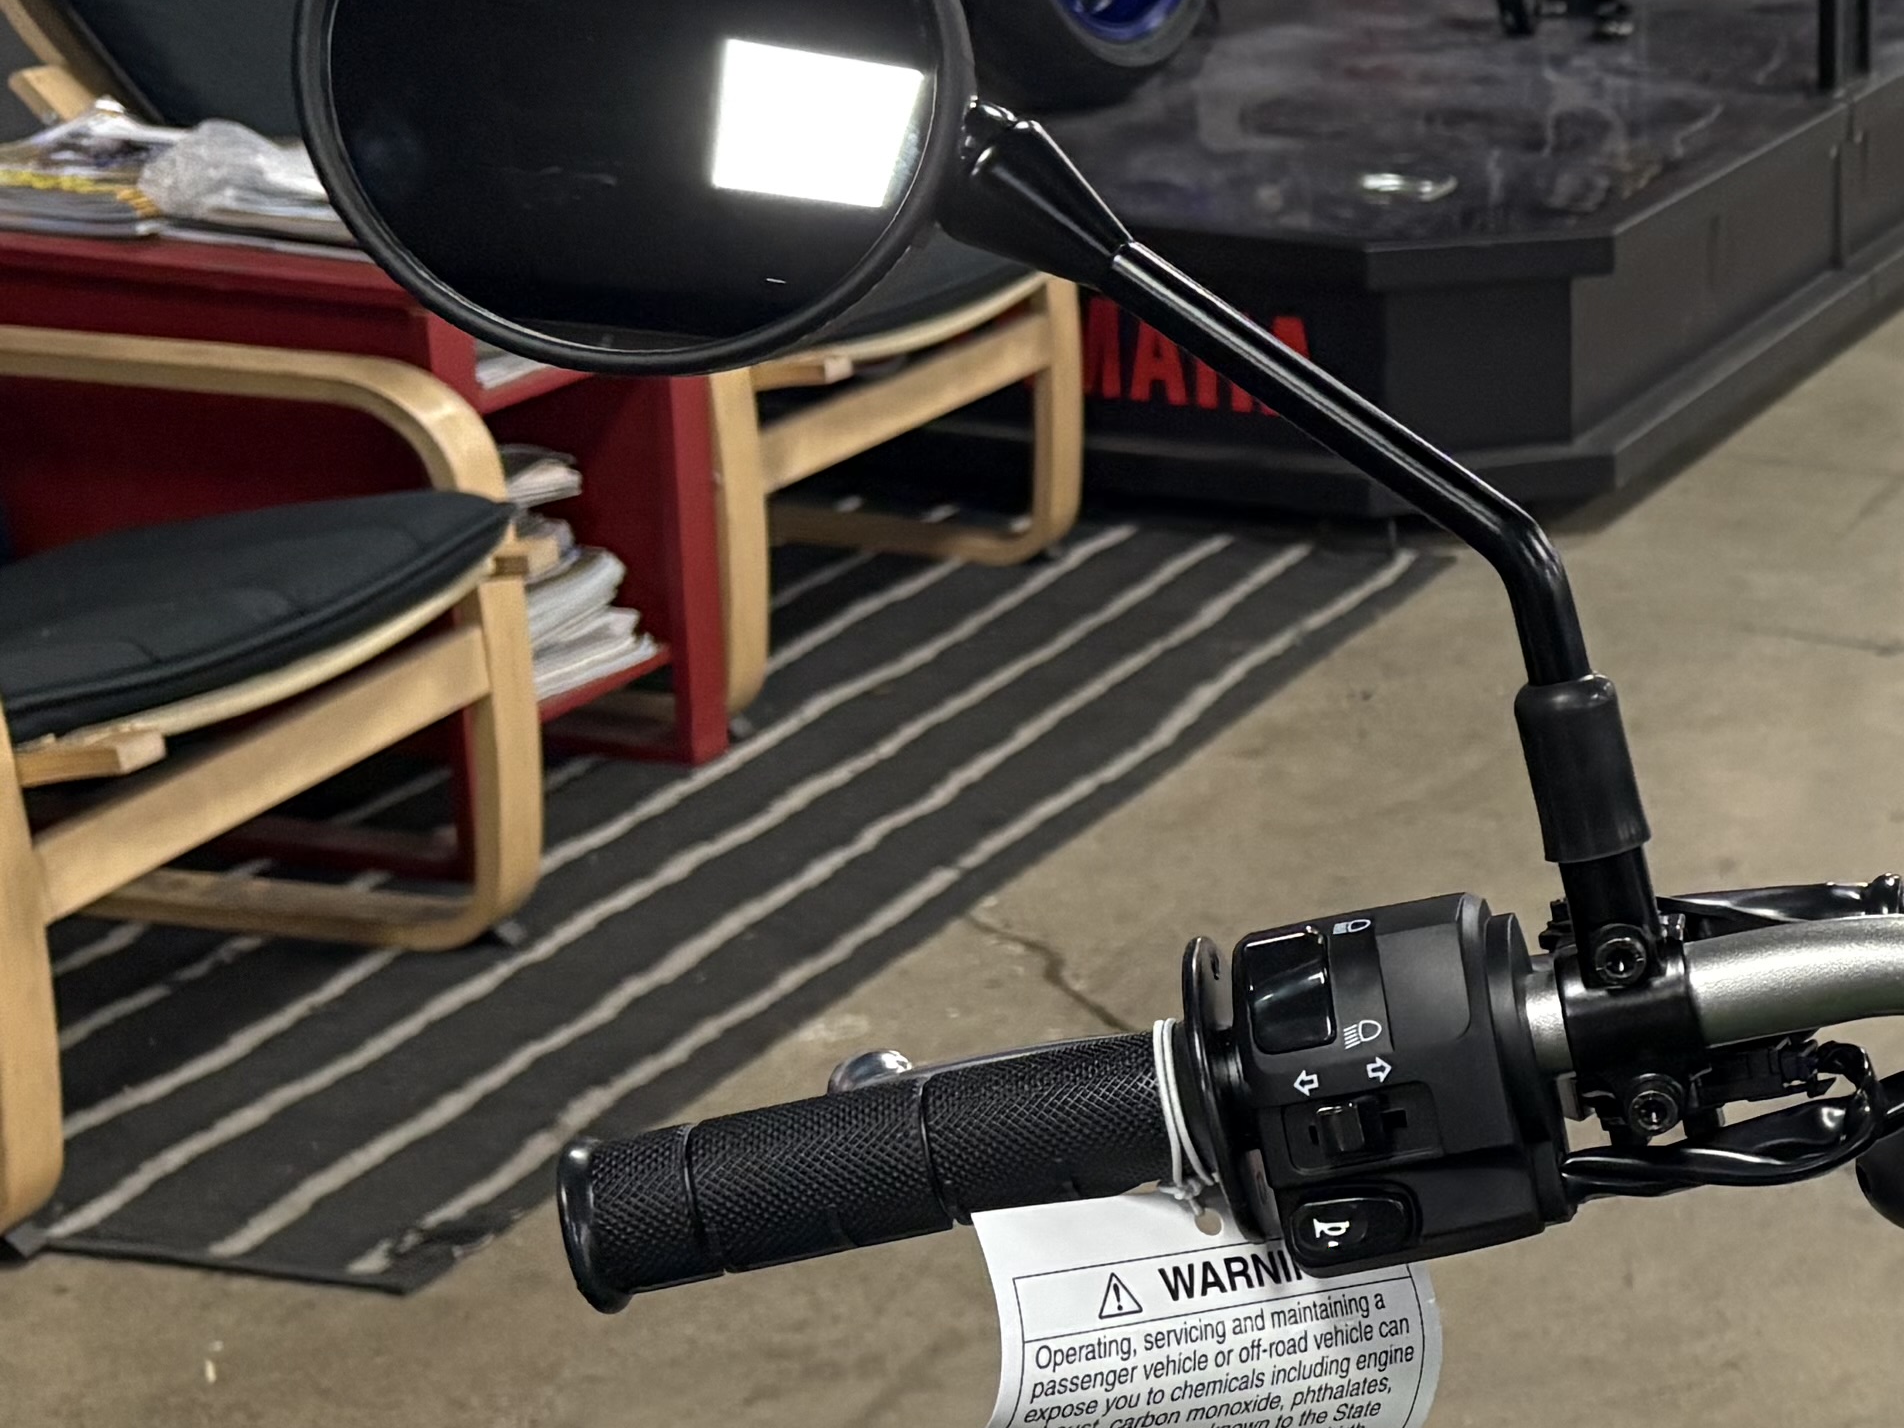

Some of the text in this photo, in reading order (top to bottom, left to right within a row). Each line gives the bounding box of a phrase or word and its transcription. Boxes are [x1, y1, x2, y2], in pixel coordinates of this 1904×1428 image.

[1159, 1250, 1304, 1302] WARNI
[1030, 1315, 1411, 1404] passenger vehicle or off-road vehicle can
[1036, 1292, 1385, 1373] Operating, servicing and maintaining a
[1024, 1344, 1415, 1428] expose you to chemicals including engine
[1186, 1391, 1284, 1423] monoxide,
[1290, 1376, 1392, 1410] phthalates,
[1298, 1409, 1328, 1427] the
[1333, 1401, 1382, 1423] State
